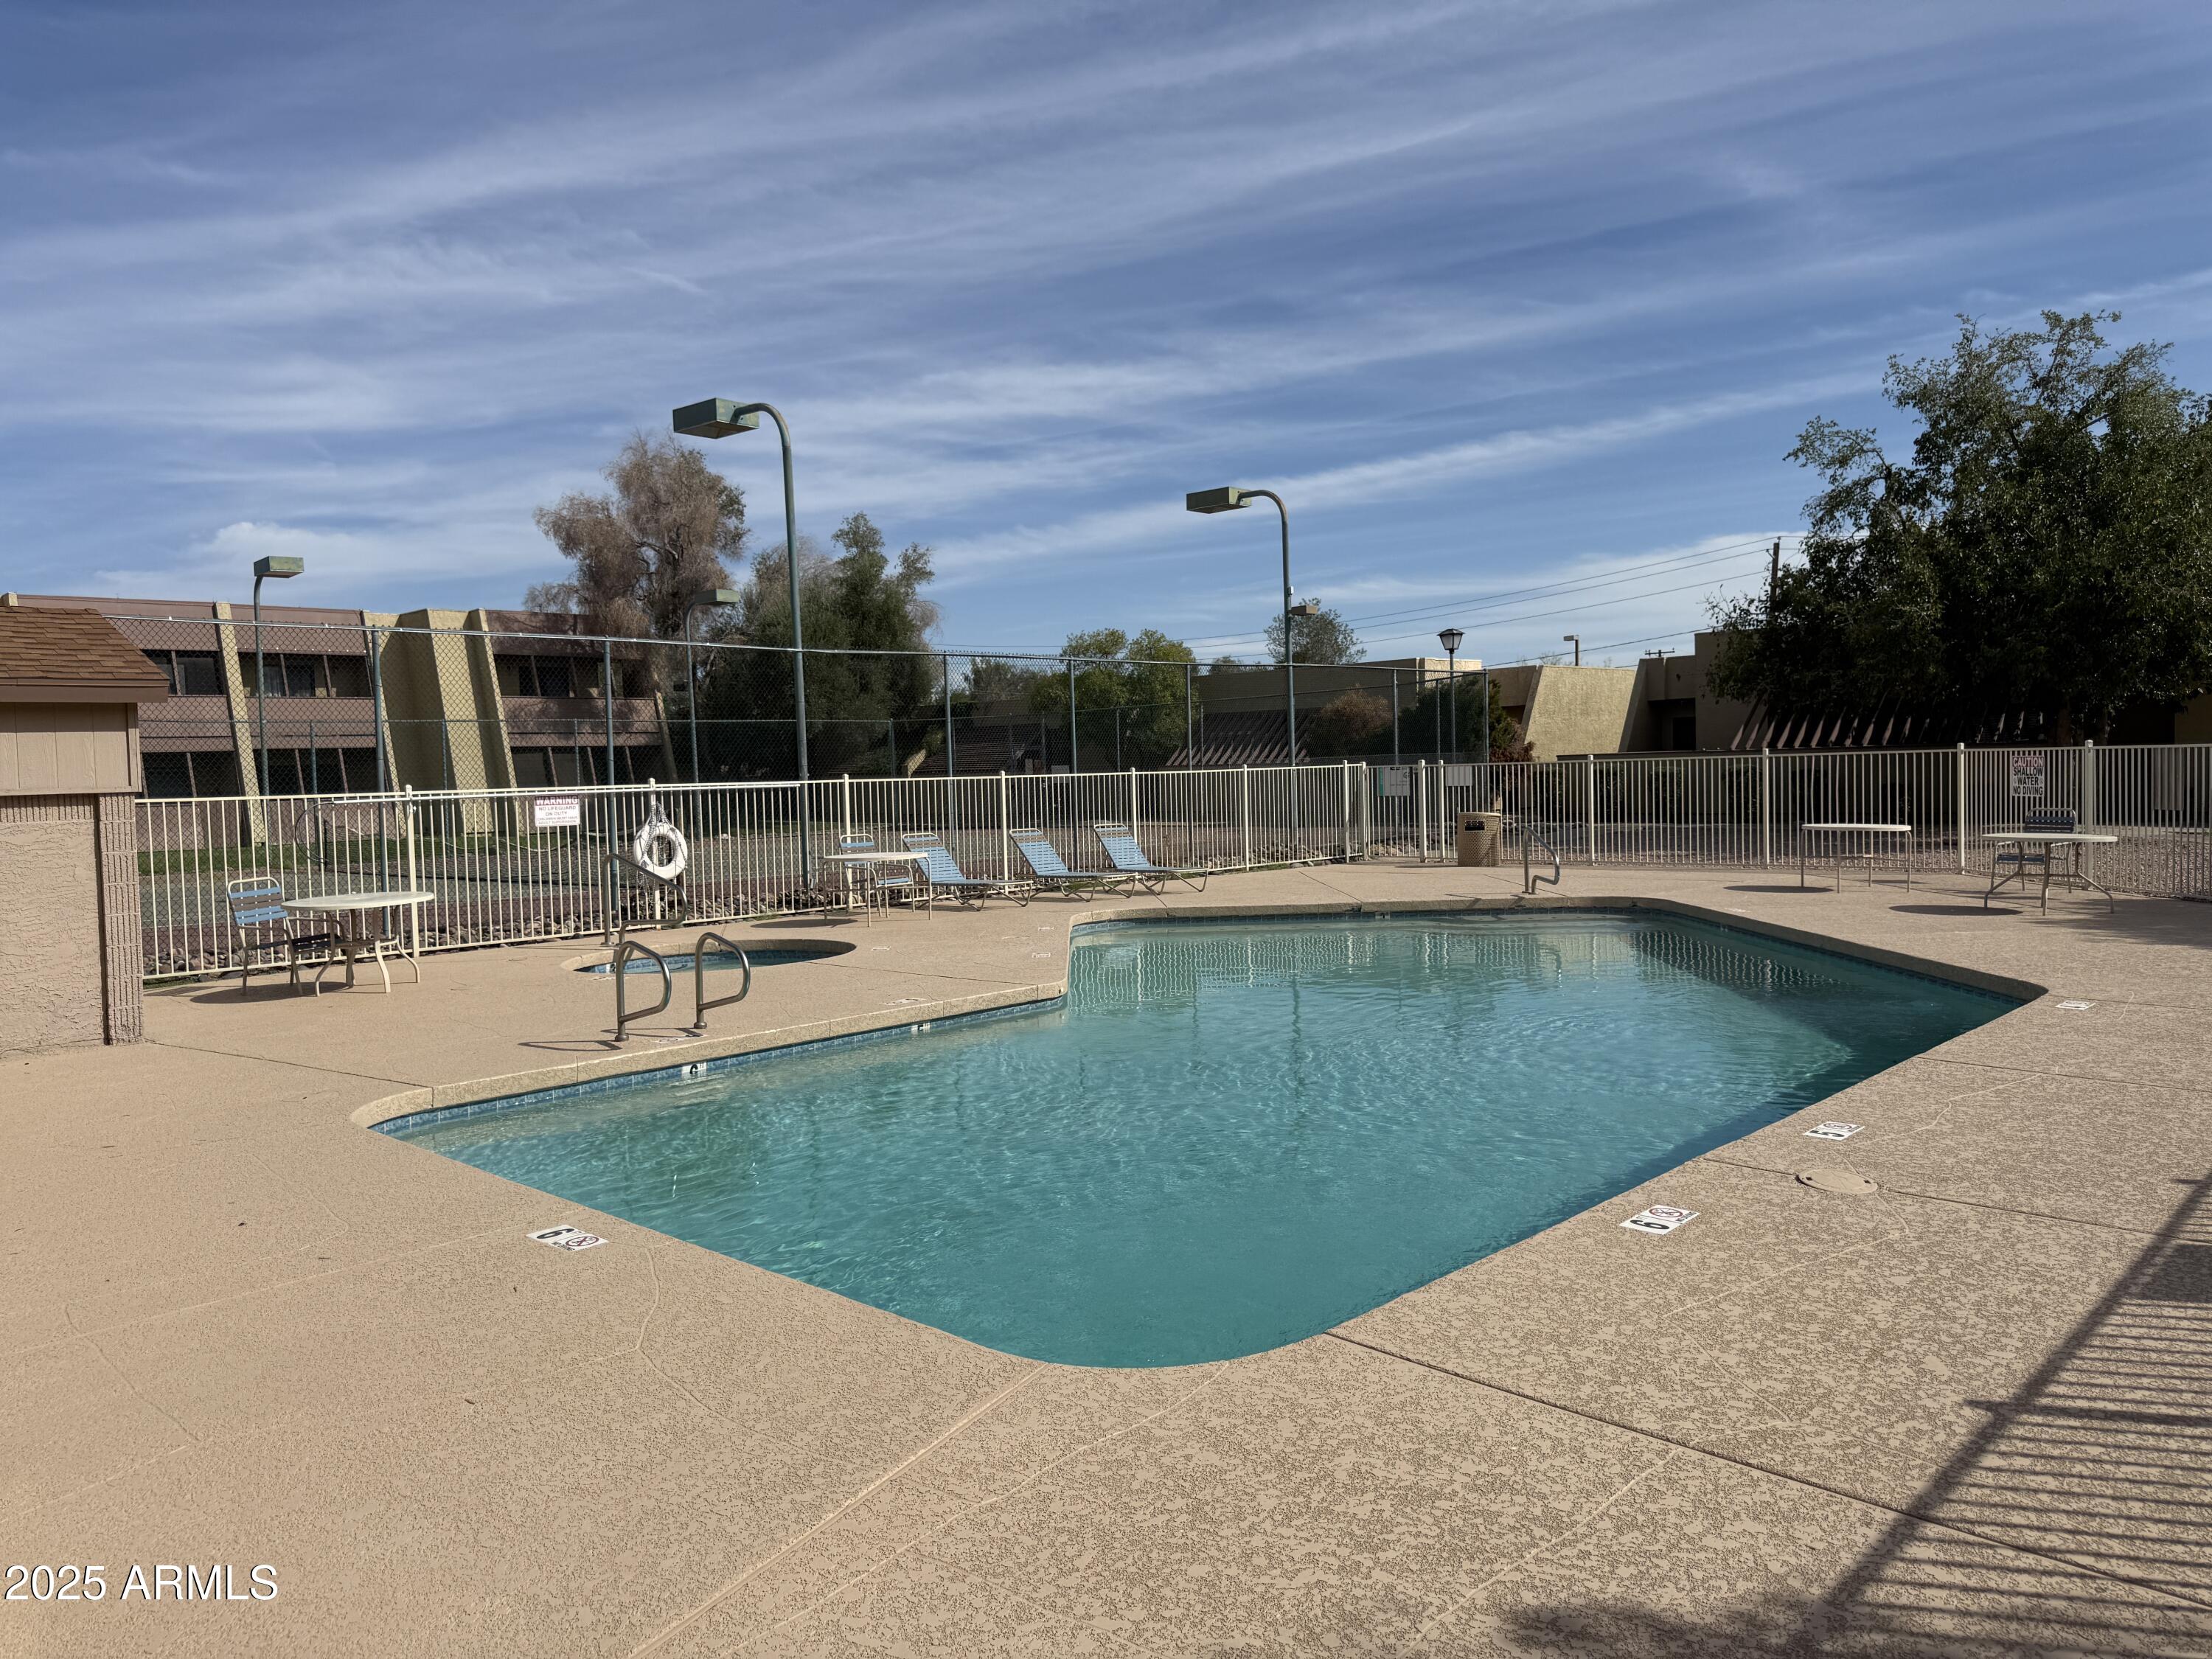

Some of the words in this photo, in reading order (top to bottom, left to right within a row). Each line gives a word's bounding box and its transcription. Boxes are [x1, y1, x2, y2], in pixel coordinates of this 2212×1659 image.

[2013, 757, 2043, 767] CAUTION
[2013, 767, 2043, 776] SHALLOW
[2017, 776, 2039, 786] WATER
[2013, 785, 2021, 795] NO
[2023, 786, 2043, 796] DIVING
[536, 796, 578, 805] WARNING
[1809, 1130, 1846, 1138] 5
[1630, 1220, 1670, 1230] 6
[536, 1228, 574, 1239] 6
